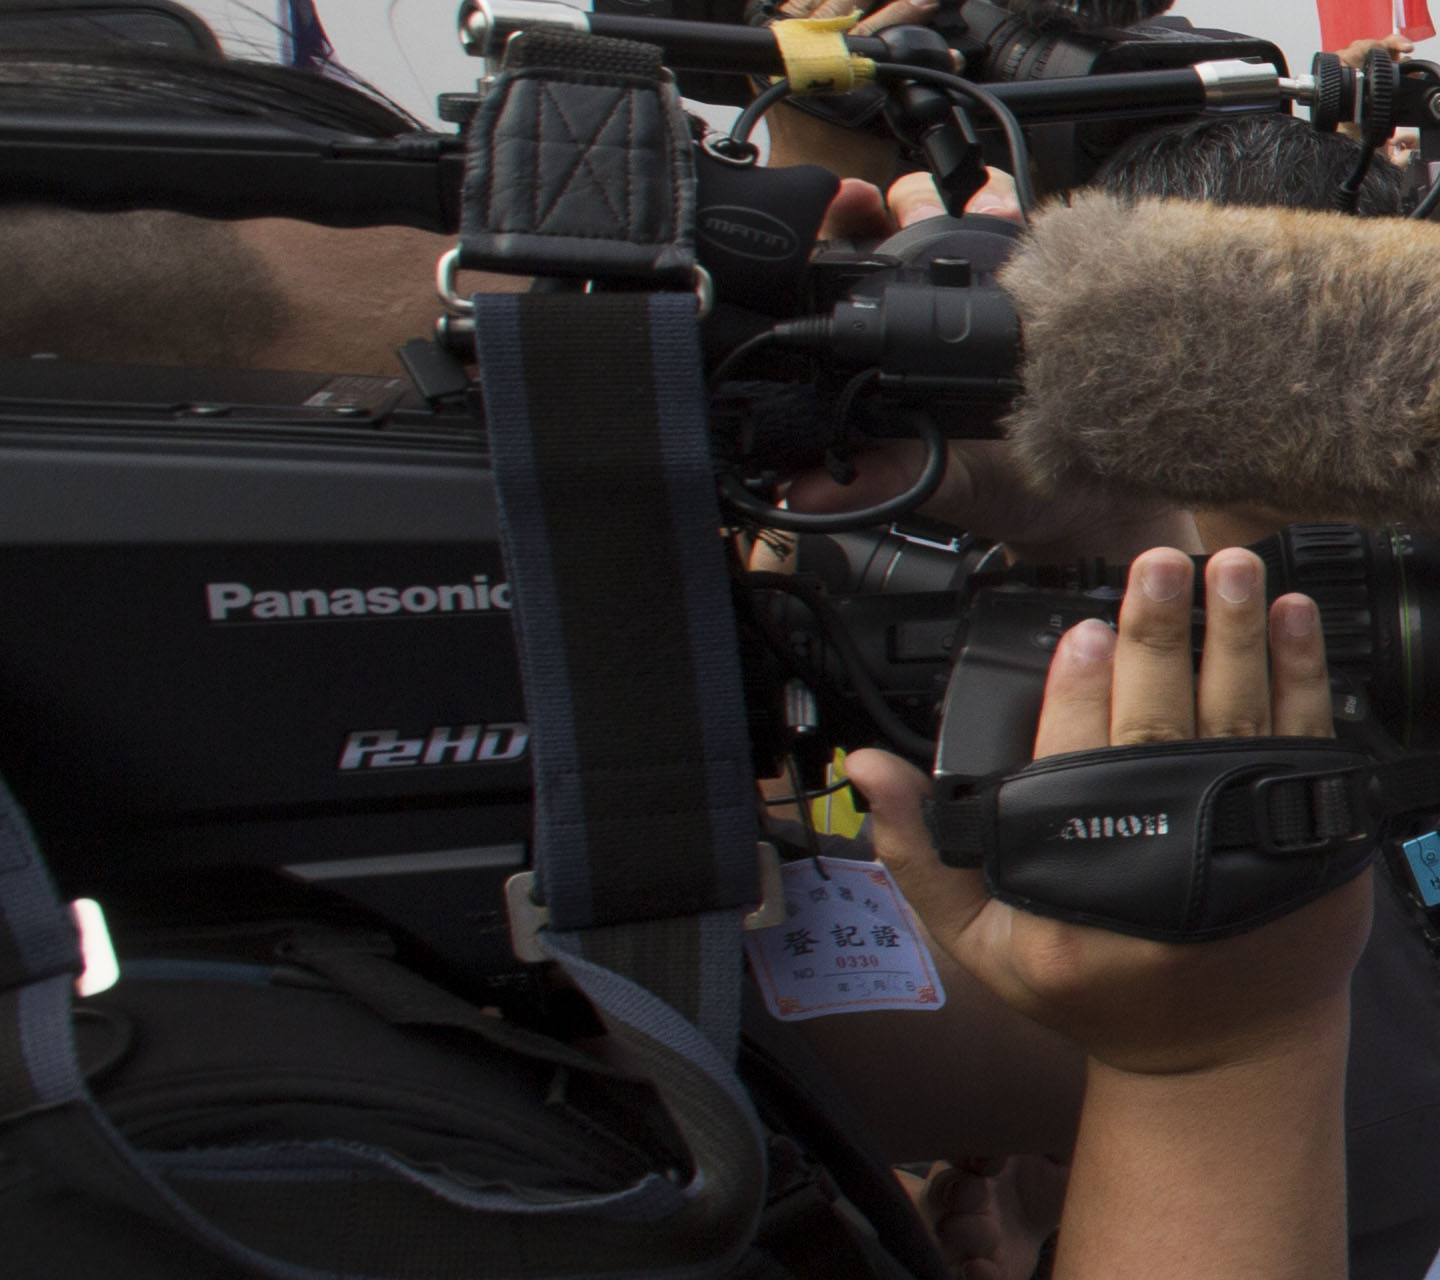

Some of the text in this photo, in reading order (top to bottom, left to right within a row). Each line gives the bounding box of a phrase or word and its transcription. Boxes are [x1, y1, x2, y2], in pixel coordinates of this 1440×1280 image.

[205, 574, 515, 622] Panasonic
[339, 722, 531, 771] P2HD
[1047, 812, 1170, 840] anon
[783, 923, 902, 957] 登記證
